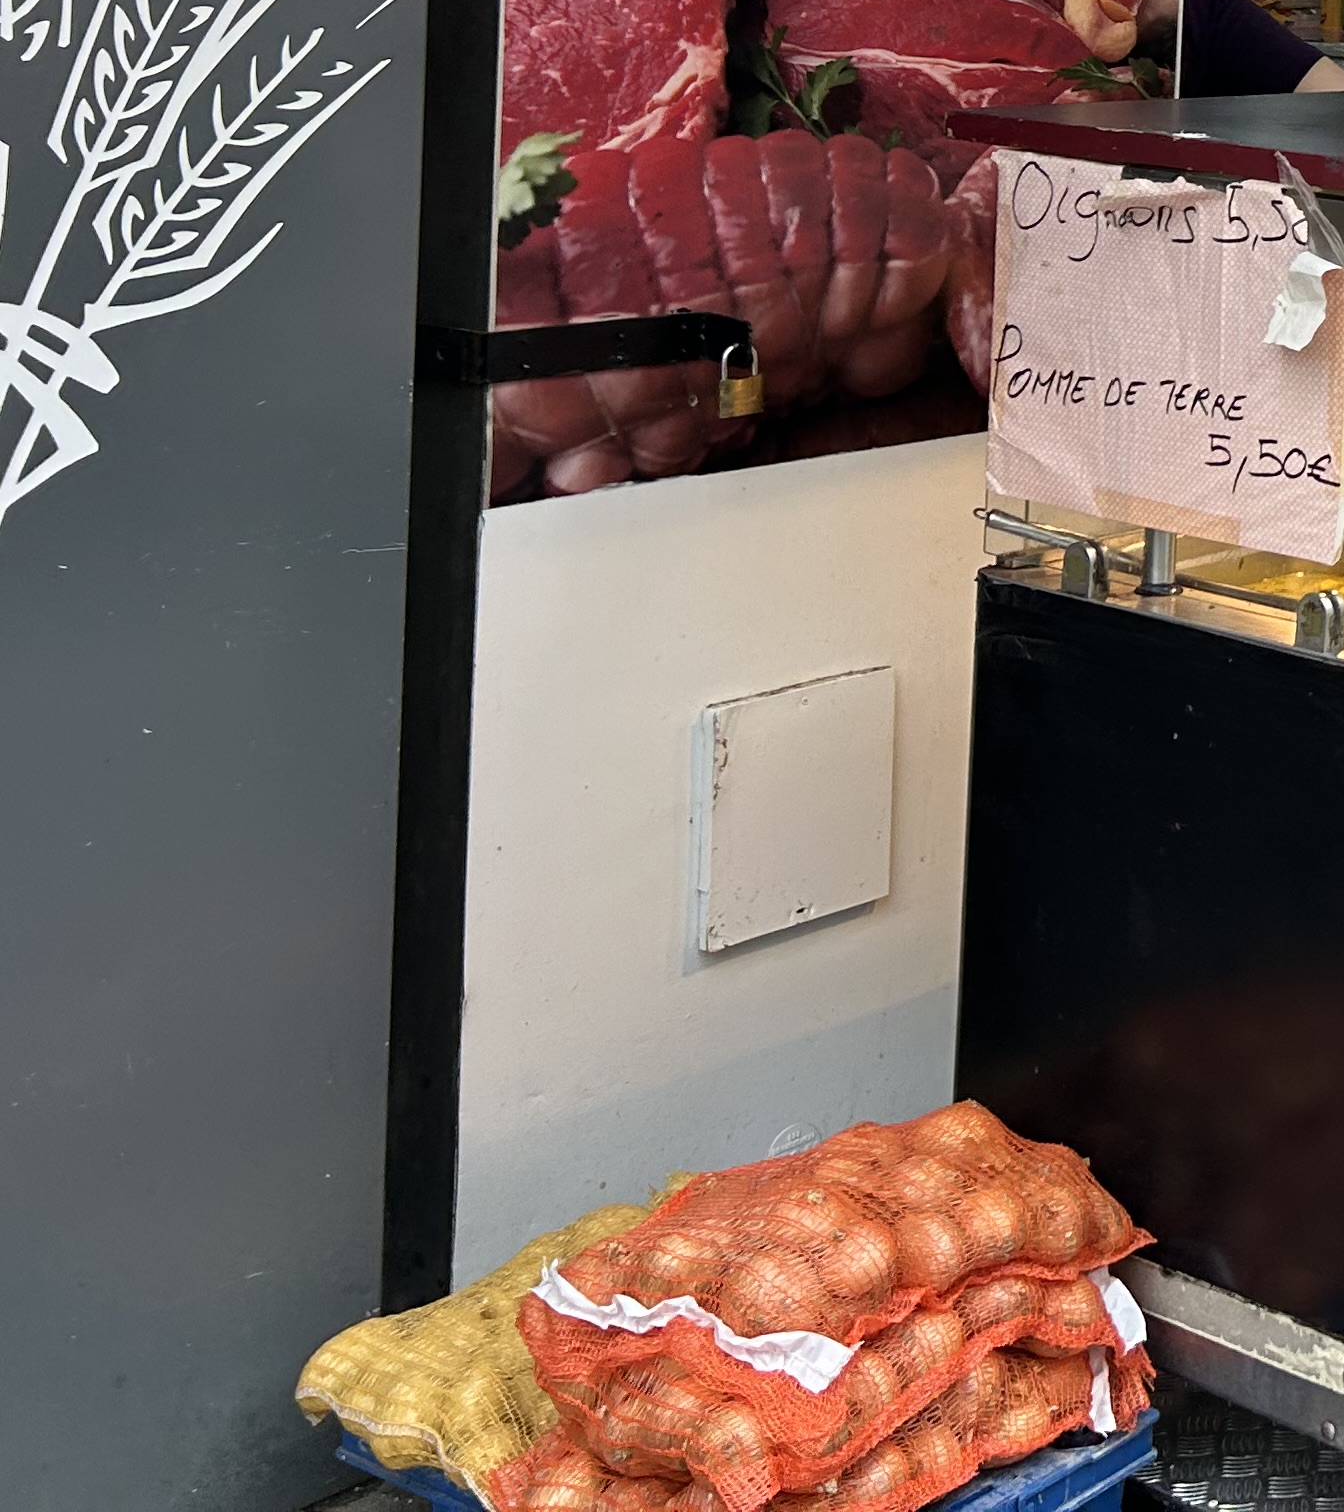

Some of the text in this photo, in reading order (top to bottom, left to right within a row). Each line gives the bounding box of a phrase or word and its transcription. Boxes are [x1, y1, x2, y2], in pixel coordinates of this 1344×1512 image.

[1011, 159, 1195, 262] Oignons
[1104, 378, 1148, 408] DE
[1161, 378, 1246, 421] TERRE
[1205, 432, 1342, 494] 5,50€
